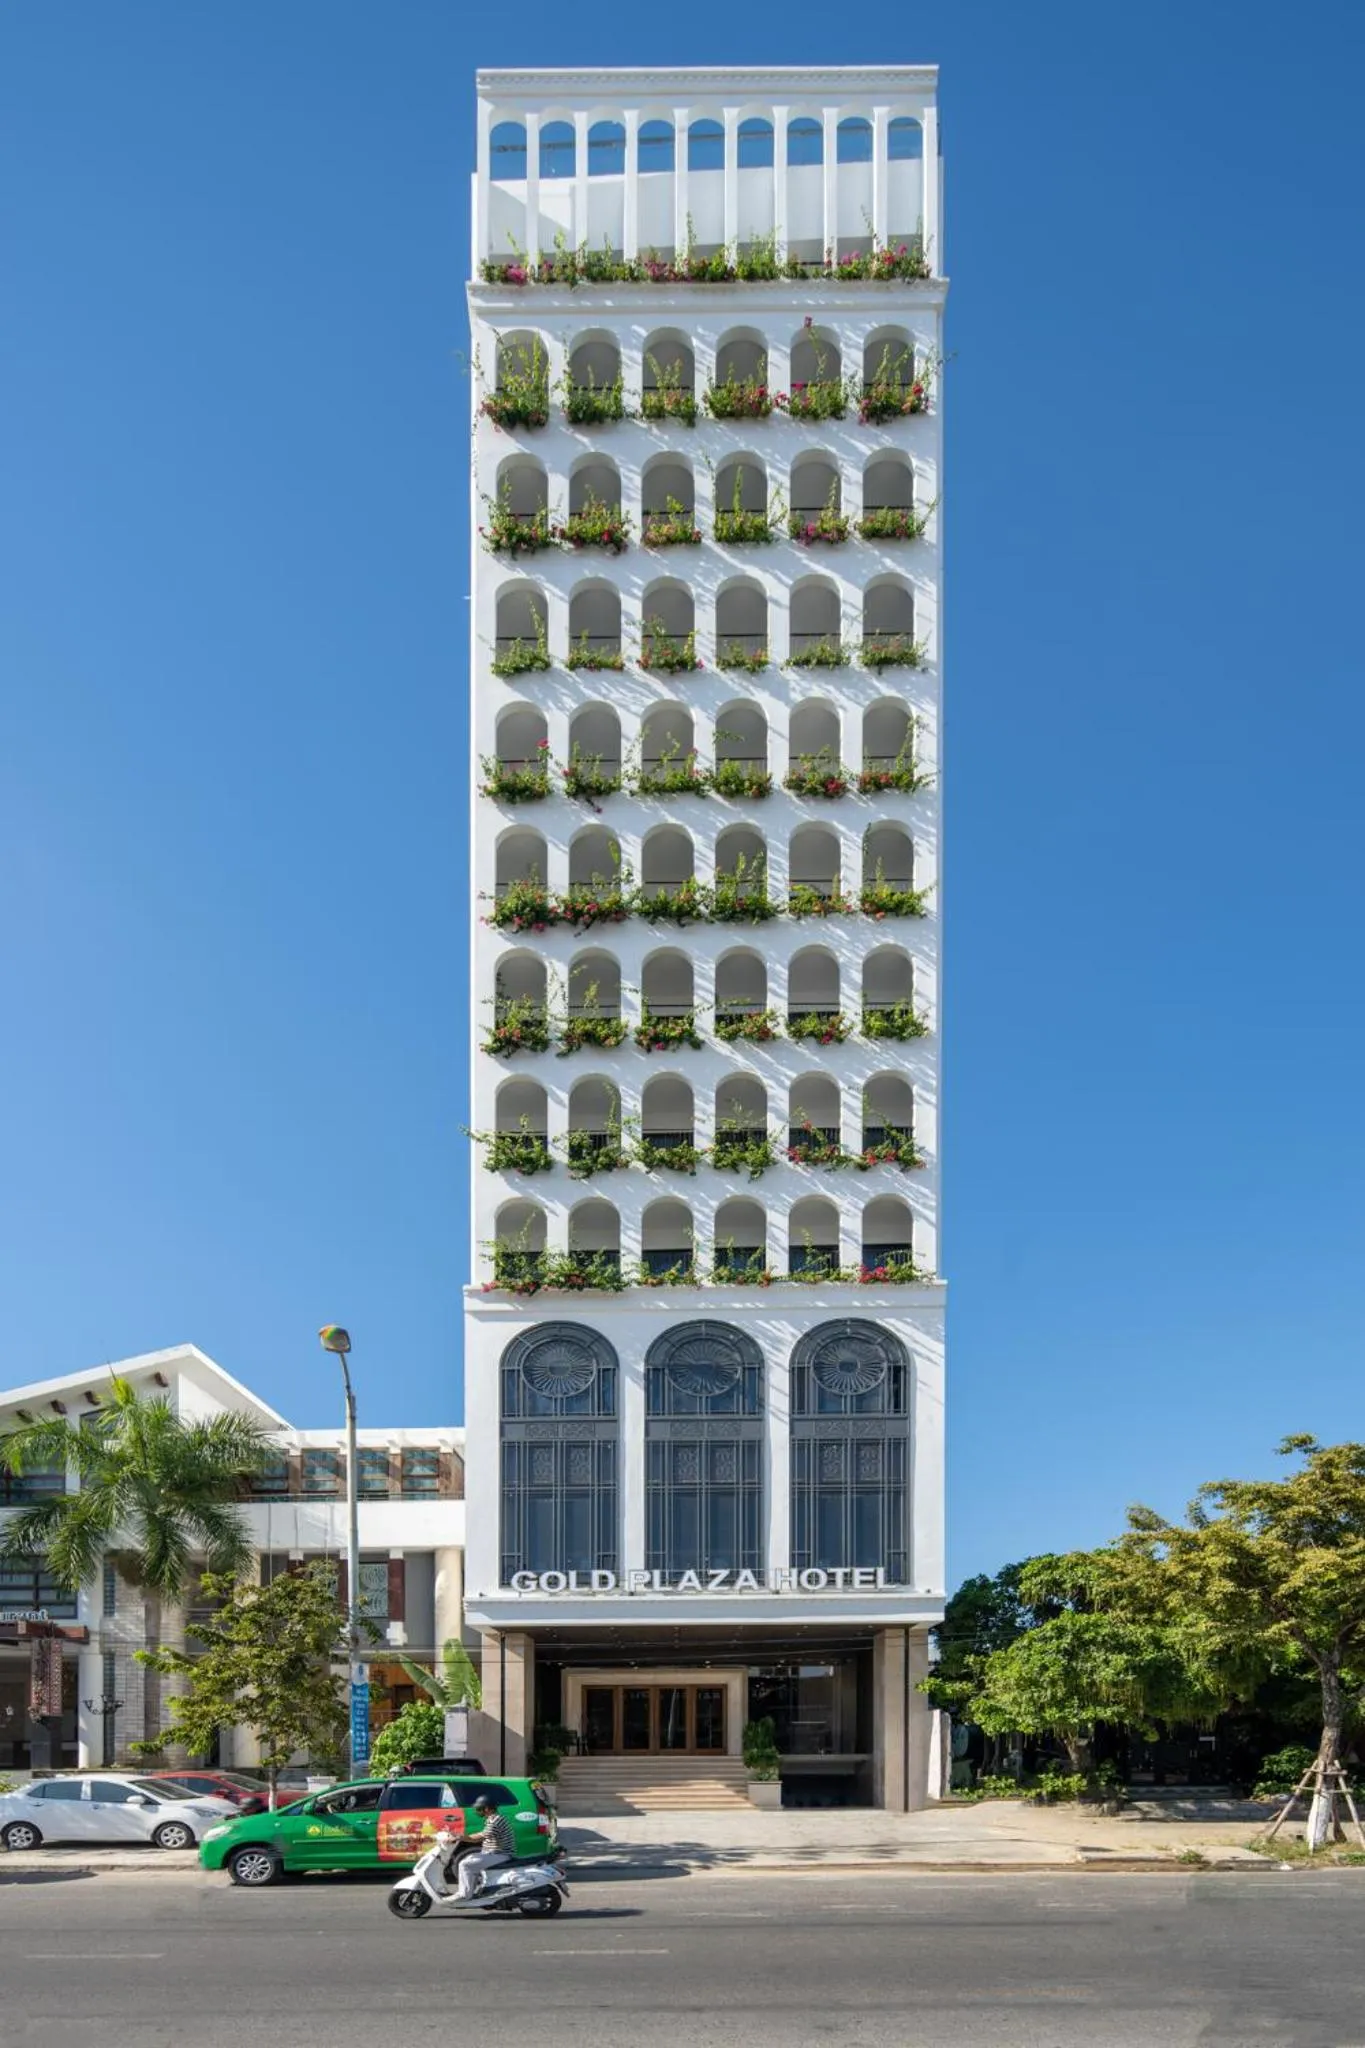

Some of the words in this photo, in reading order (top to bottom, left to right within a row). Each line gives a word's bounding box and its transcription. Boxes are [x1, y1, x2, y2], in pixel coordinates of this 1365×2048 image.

[511, 1570, 616, 1593] GOLD
[629, 1569, 759, 1592] PLAZA
[775, 1567, 896, 1590] HOTEL
